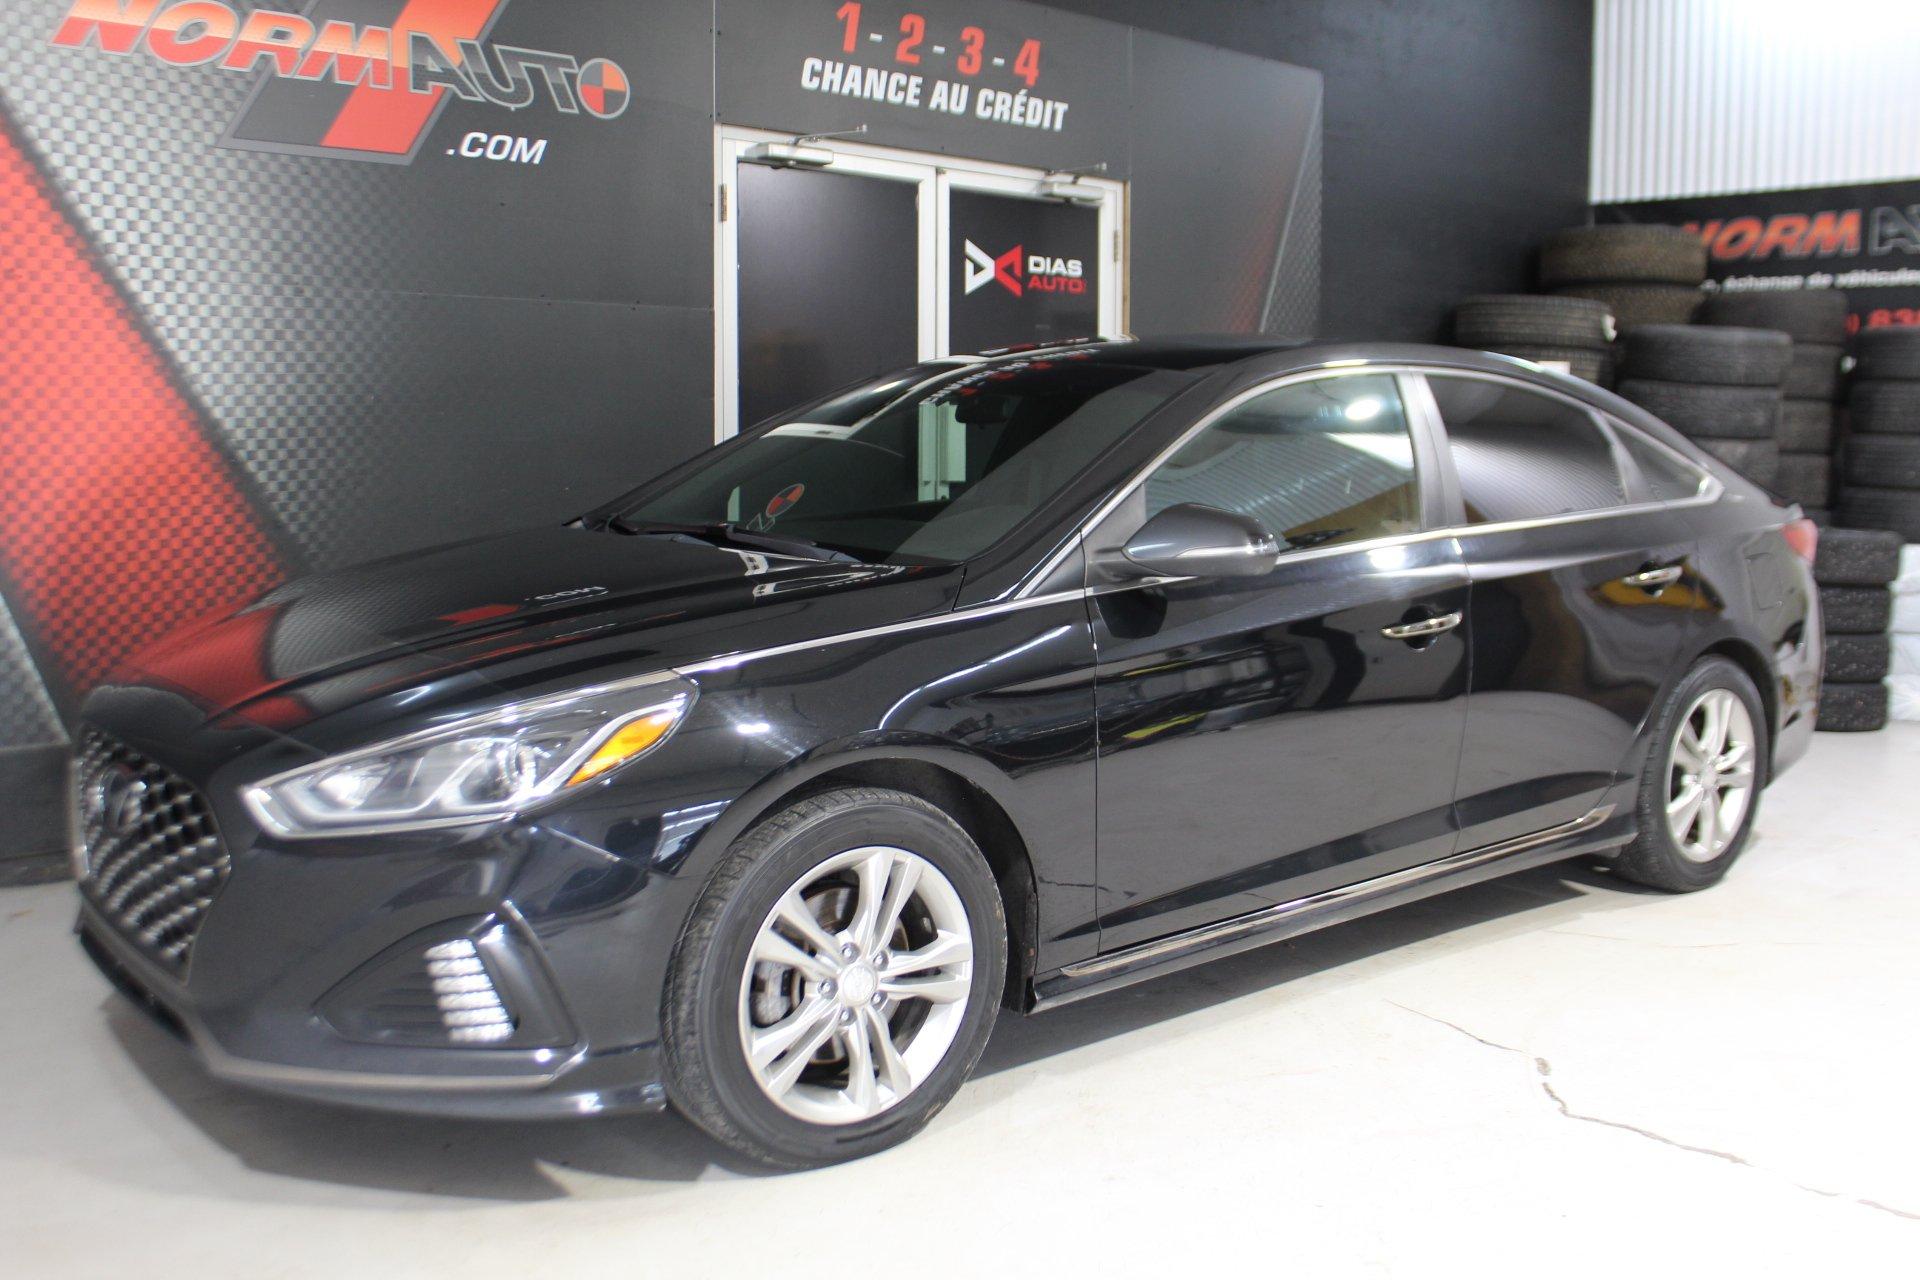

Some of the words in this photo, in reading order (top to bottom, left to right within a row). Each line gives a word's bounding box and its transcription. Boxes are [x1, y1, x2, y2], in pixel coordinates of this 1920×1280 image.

[801, 57, 923, 107] CHANCE
[929, 80, 969, 115] AU
[976, 88, 1069, 132] CRÉDIT
[446, 131, 547, 165] .COM
[1028, 255, 1083, 277] DIAS
[1028, 274, 1087, 295] AUTO
